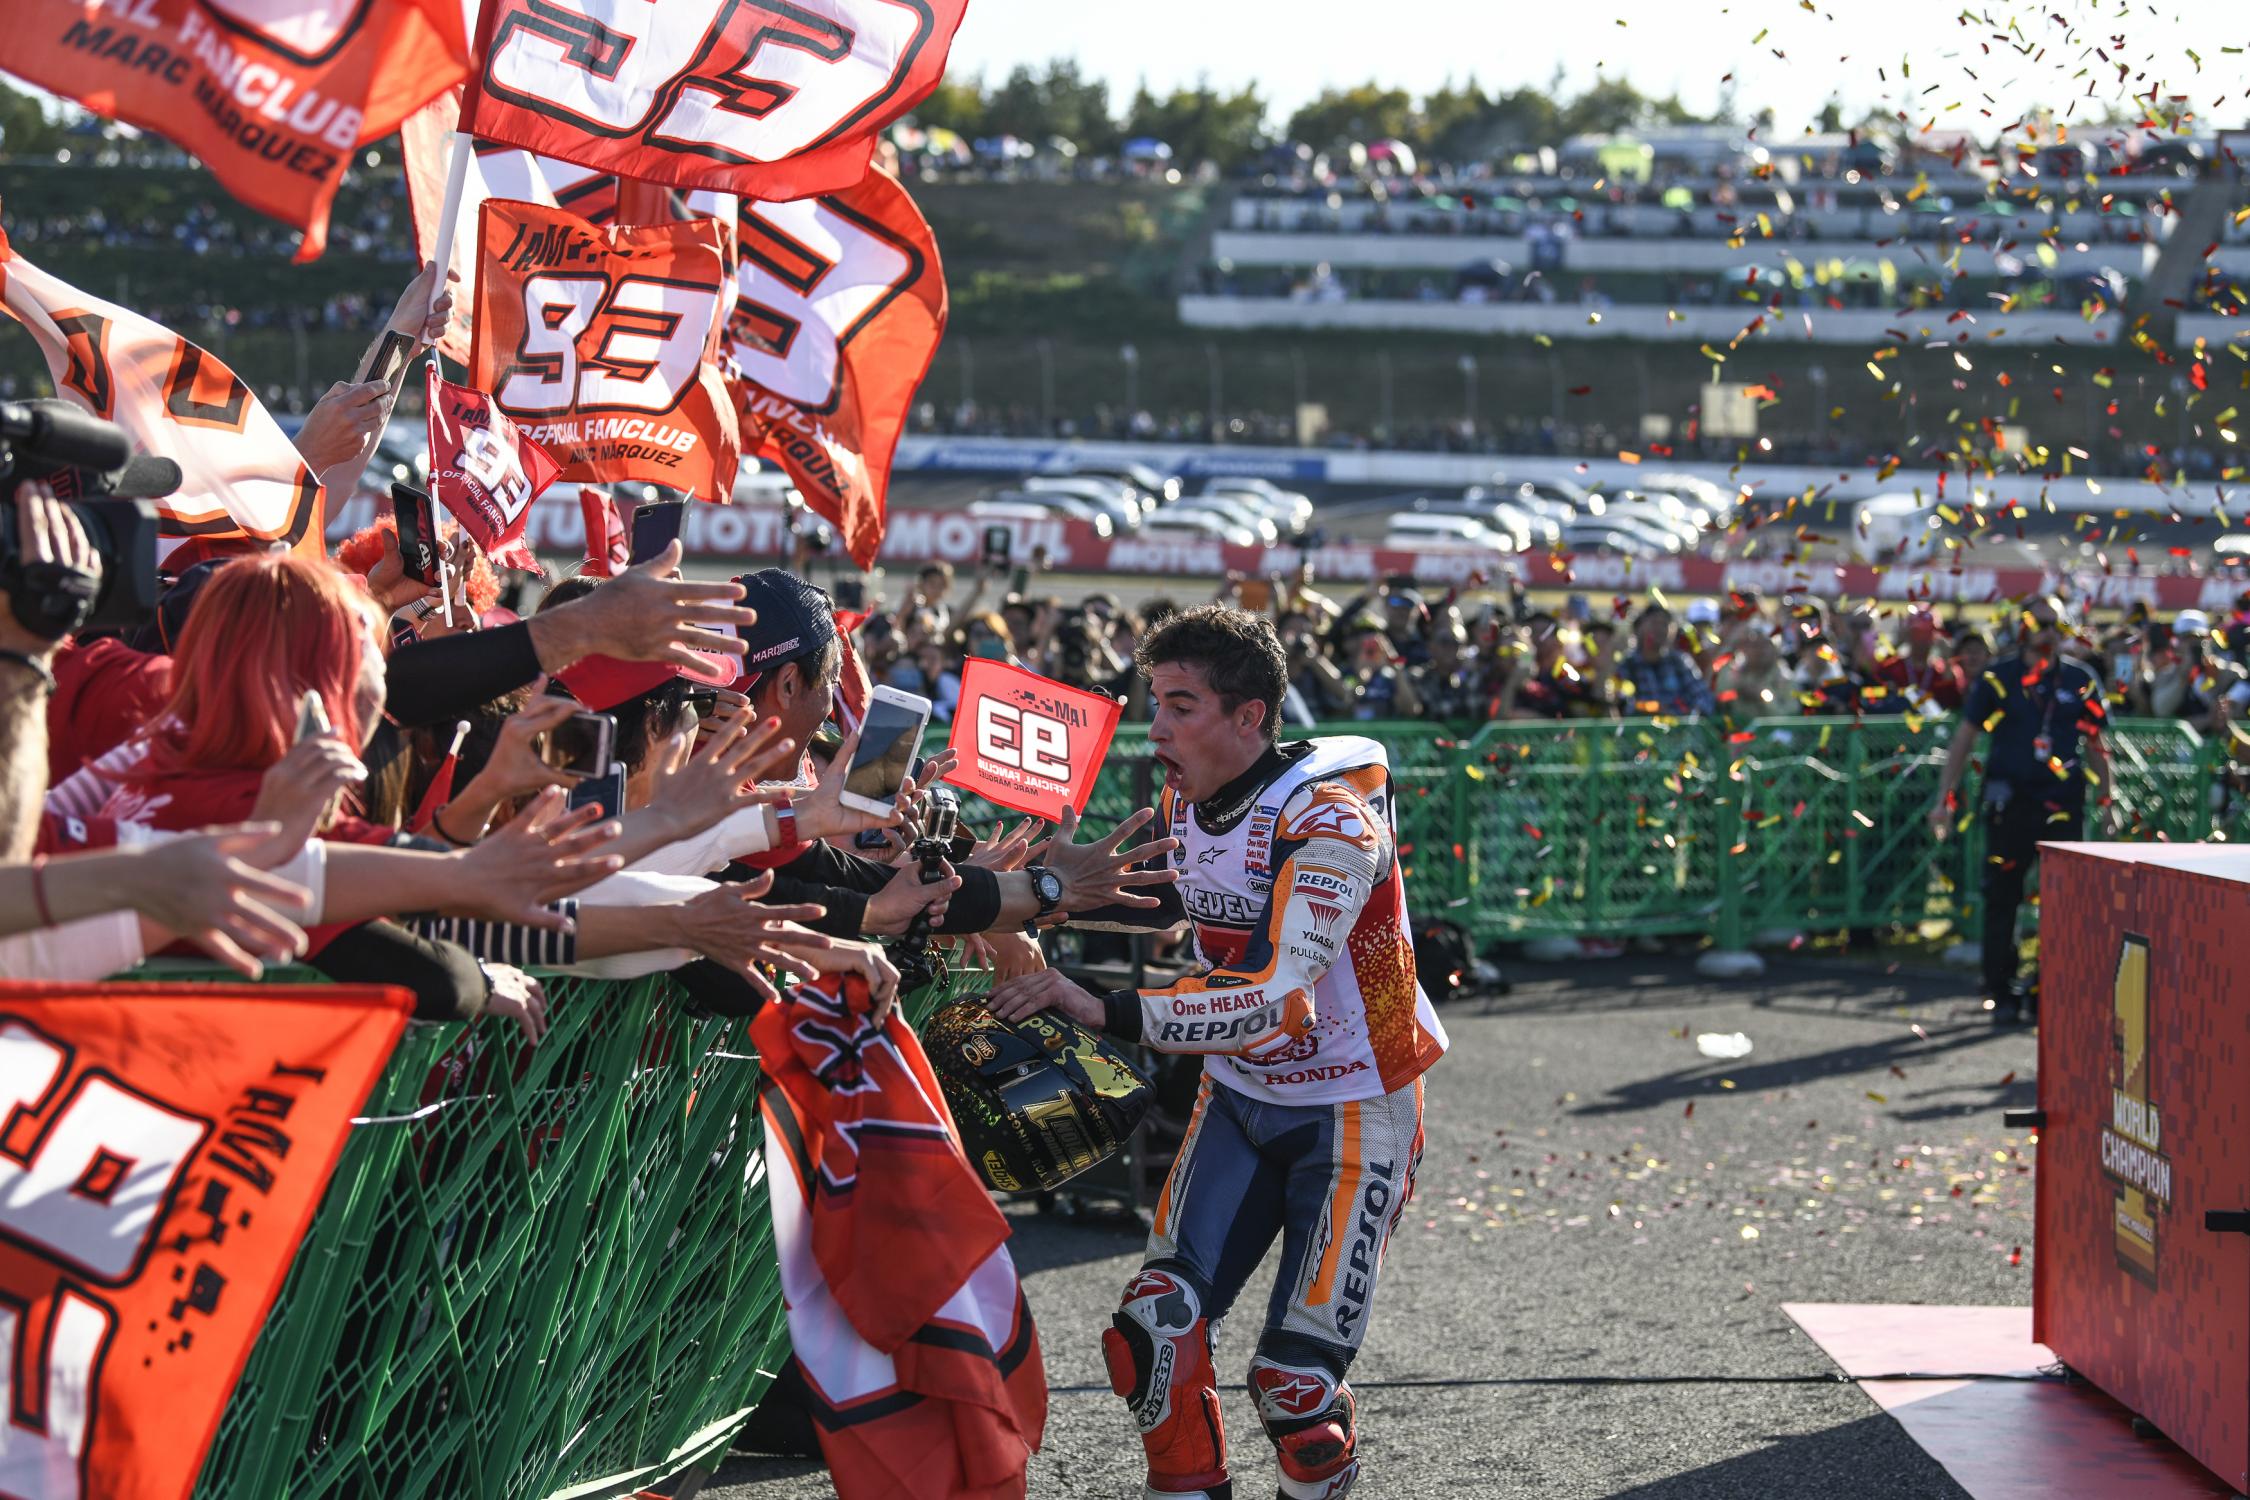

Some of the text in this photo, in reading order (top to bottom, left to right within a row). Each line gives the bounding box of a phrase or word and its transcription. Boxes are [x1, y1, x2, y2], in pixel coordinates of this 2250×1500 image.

[61, 19, 193, 85] MARC
[178, 9, 364, 149] FANCLUB
[511, 224, 572, 272] AM
[492, 271, 720, 417] 93
[584, 418, 697, 452] FANCLUB
[442, 470, 483, 502] OFFICIAL
[1106, 540, 1225, 572] MOTUL
[1182, 884, 1263, 921] LEVEL
[1298, 873, 1353, 899] REPSOL
[1302, 930, 1335, 951] YUASA
[1160, 1008, 1283, 1042] REPSOL
[1172, 999, 1206, 1016] One
[1264, 1060, 1370, 1086] HONDA
[2113, 1090, 2160, 1149] WORLD
[2101, 1131, 2171, 1201] CHAMPION
[1335, 1158, 1394, 1340] REPSOL
